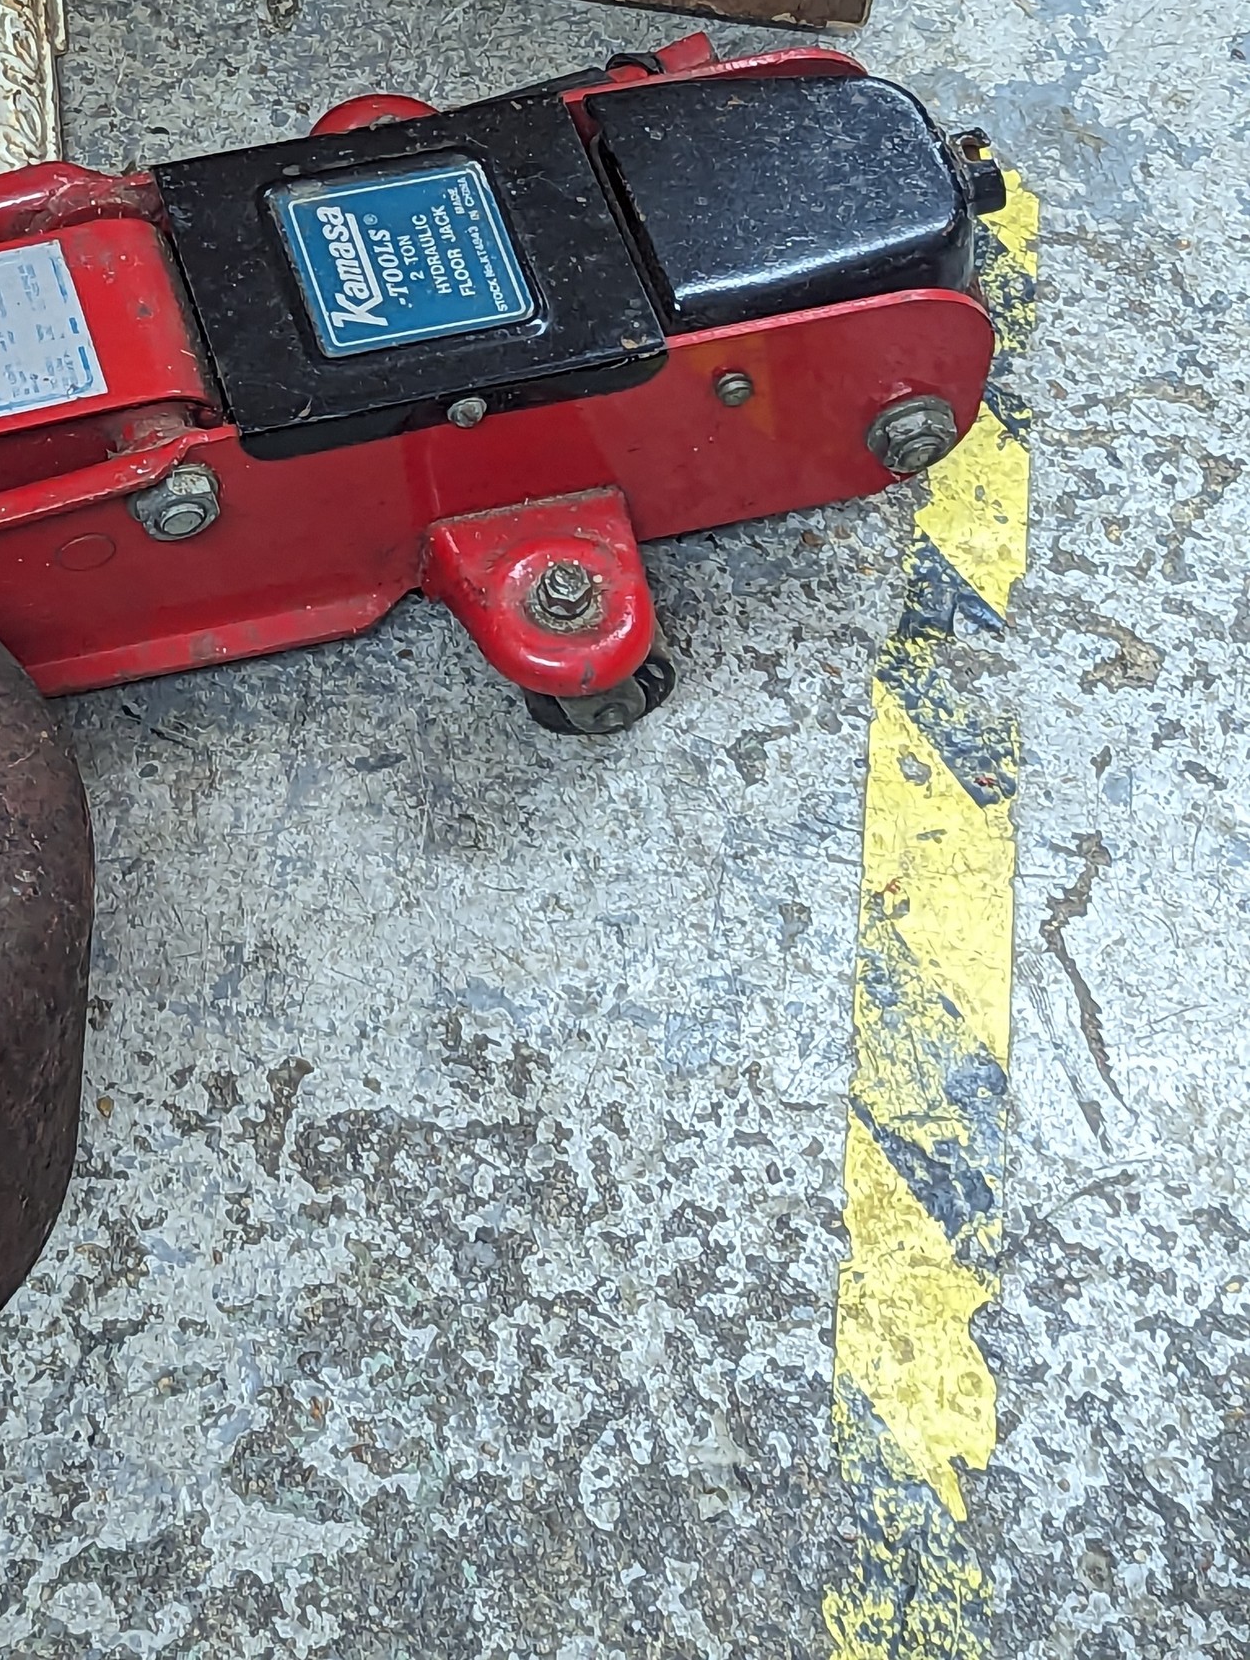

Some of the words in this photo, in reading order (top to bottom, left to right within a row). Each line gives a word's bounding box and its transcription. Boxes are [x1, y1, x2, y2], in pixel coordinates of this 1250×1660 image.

[447, 187, 465, 215] MADE
[431, 205, 456, 242] JACK
[316, 206, 389, 328] Kamasa
[397, 235, 419, 265] TON
[412, 214, 452, 294] HYDRAULIC
[410, 270, 425, 281] 2
[447, 248, 476, 297] FLOOR
[487, 278, 509, 312] STOCK
